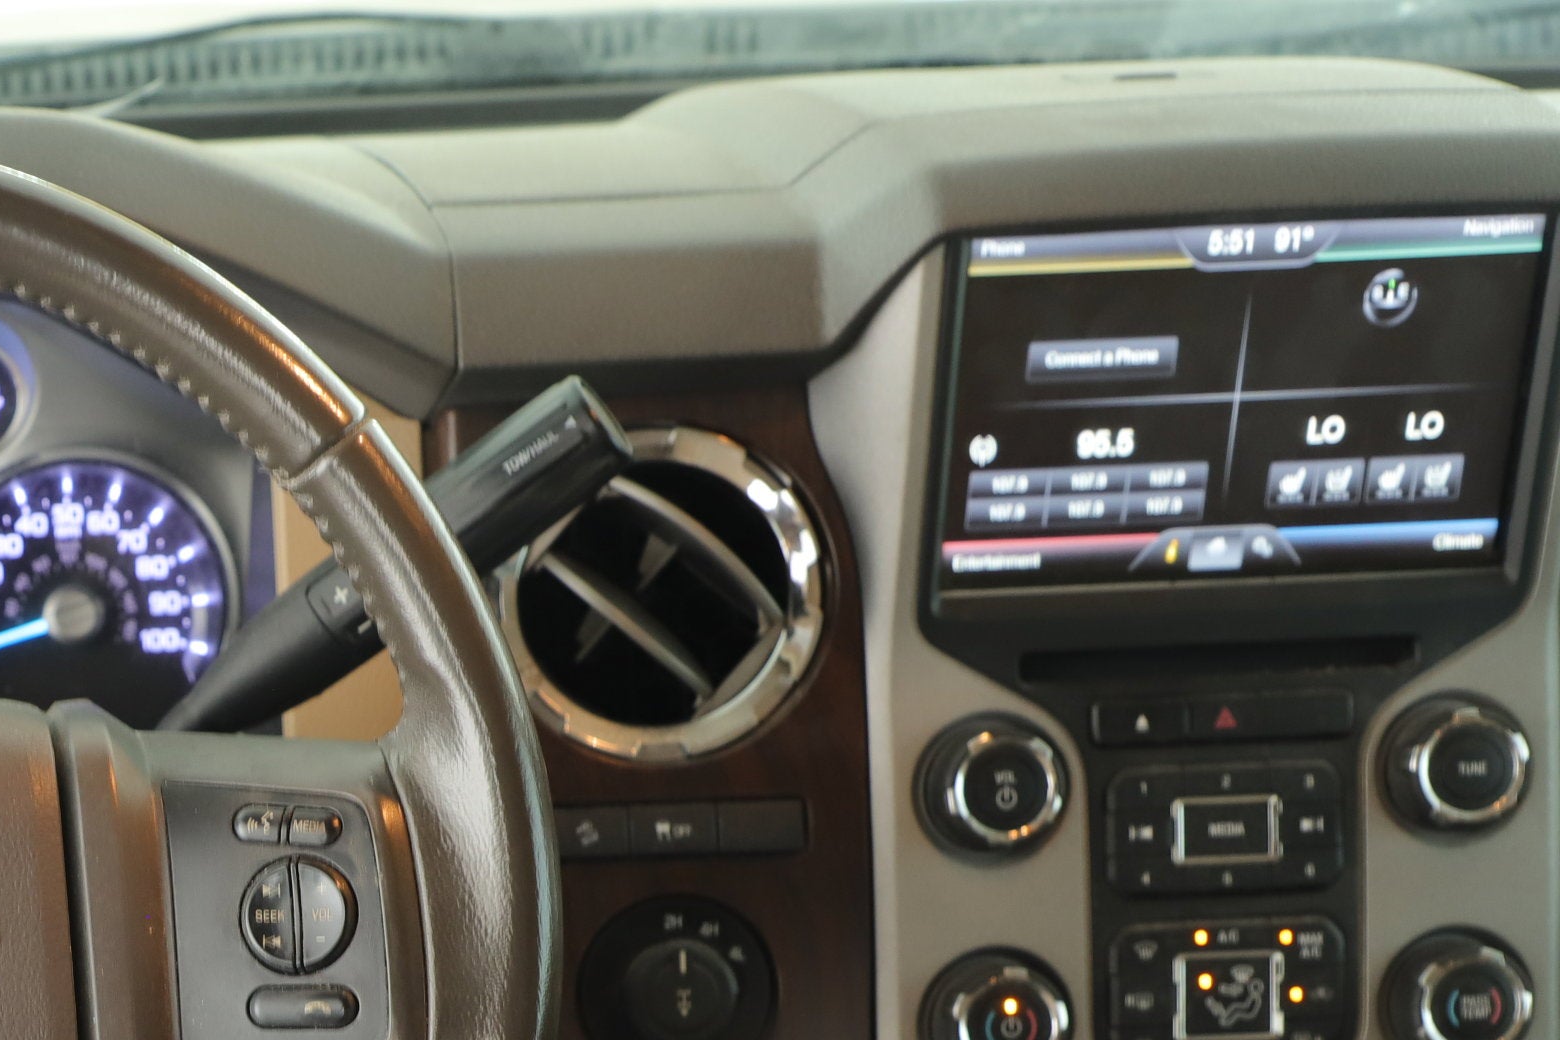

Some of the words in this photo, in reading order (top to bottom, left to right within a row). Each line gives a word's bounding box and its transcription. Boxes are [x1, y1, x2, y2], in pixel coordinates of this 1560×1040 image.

[1462, 216, 1535, 237] Navigation
[980, 238, 1026, 258] Phone
[1044, 350, 1101, 369] Connect
[1115, 346, 1160, 366] Phone
[1306, 414, 1346, 446] LO
[1404, 410, 1445, 441] LO
[14, 511, 49, 538] 40
[85, 509, 120, 536] 60
[116, 528, 148, 555] 70
[1432, 532, 1485, 552] Climate
[134, 554, 170, 581] 80
[148, 590, 182, 617] 90
[140, 627, 181, 654] 100
[1458, 760, 1488, 776] TUNE
[293, 819, 326, 834] MEDIA
[1207, 821, 1246, 838] MEDIA
[255, 908, 285, 924] SEEK
[312, 908, 334, 923] VOL
